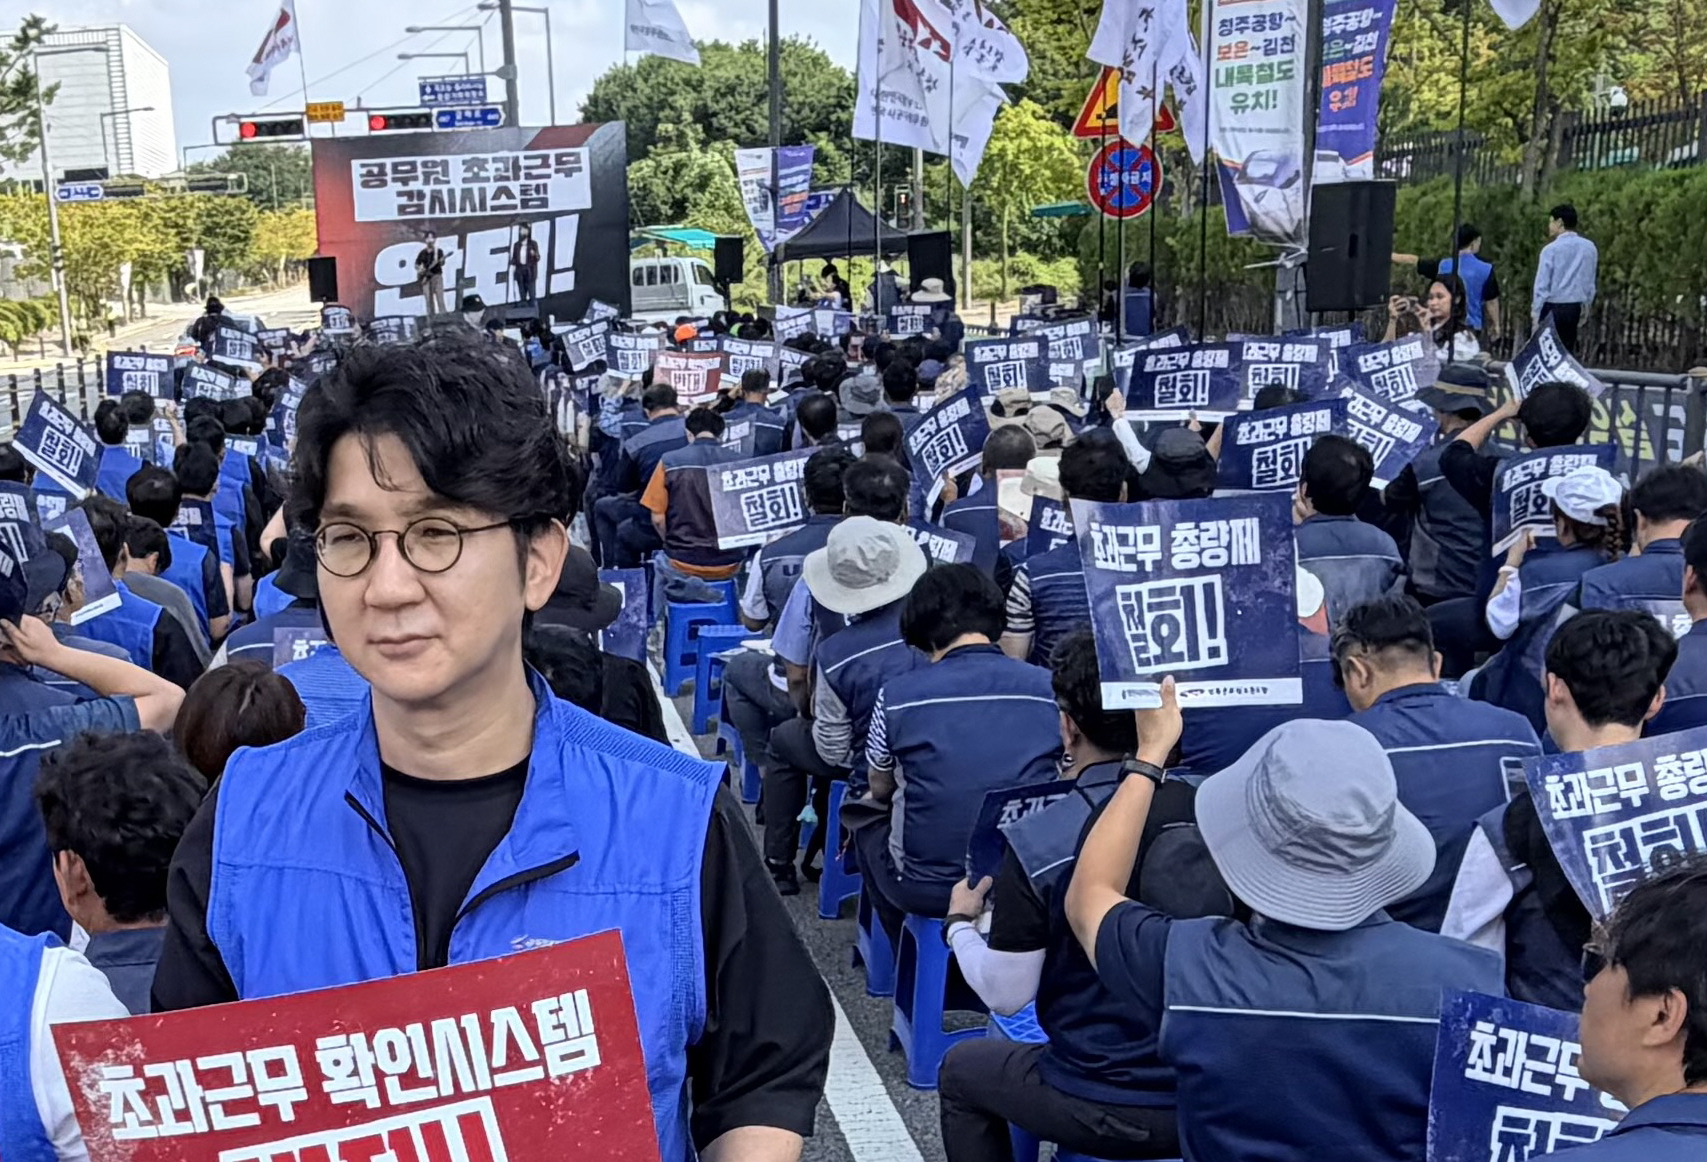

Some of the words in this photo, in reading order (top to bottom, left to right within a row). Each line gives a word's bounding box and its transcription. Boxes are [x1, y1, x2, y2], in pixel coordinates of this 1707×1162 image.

[1215, 59, 1295, 88] 내륙철도
[1230, 89, 1278, 115] 유치!
[359, 159, 450, 189] 공무원
[461, 152, 583, 184] 초과근무
[396, 183, 549, 216] 감시시스템
[1154, 369, 1210, 409] 철회!
[38, 425, 83, 478] 철회!
[921, 422, 968, 480] 철회!
[740, 481, 804, 532] 철회!
[1170, 517, 1261, 570] 총량제
[1115, 574, 1230, 675] 철회!
[1544, 760, 1647, 821] 초과근무
[98, 1043, 308, 1141] 초과근무
[313, 988, 602, 1110] 확인시스템
